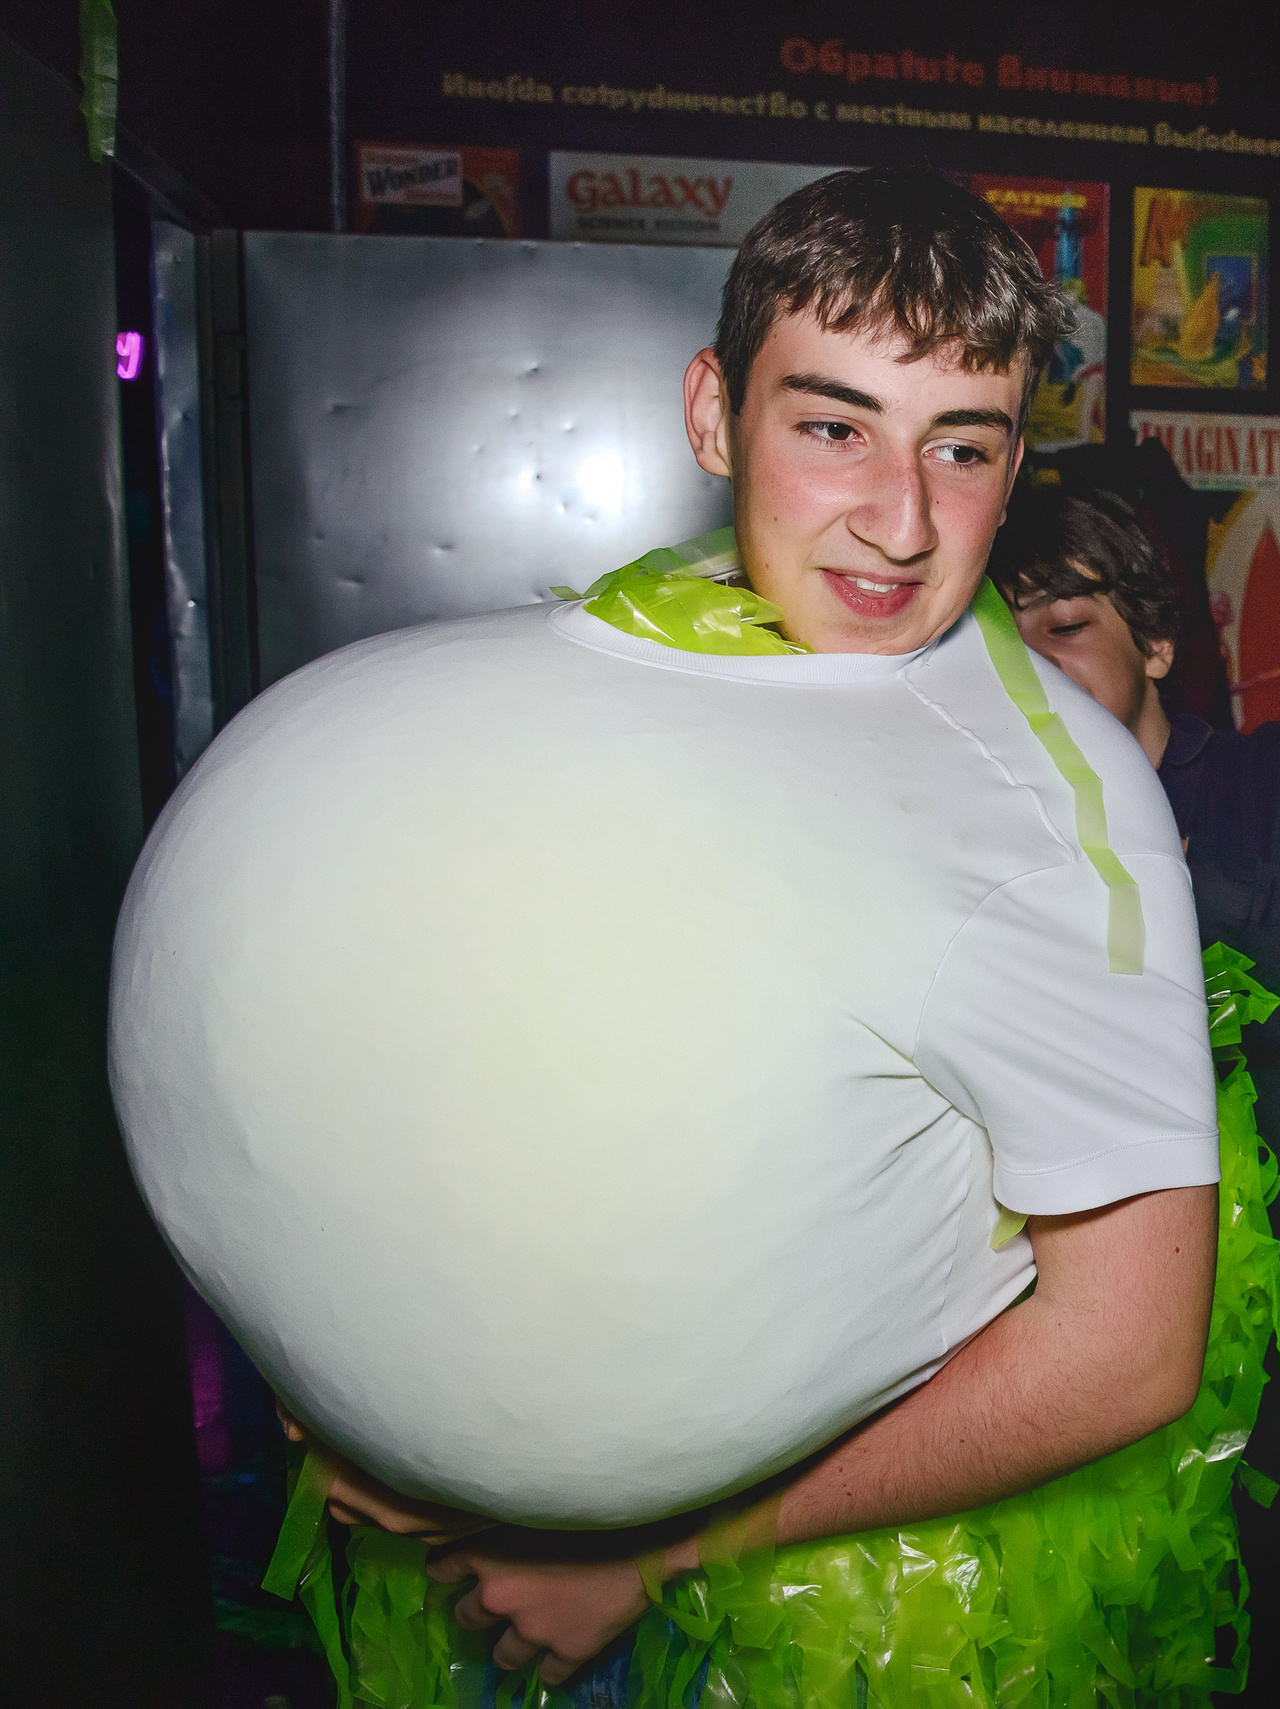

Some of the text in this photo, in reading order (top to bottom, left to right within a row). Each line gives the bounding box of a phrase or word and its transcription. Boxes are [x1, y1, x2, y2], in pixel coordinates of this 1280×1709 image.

[441, 71, 554, 103] Иногда
[814, 102, 830, 121] с
[836, 101, 972, 131] местным
[977, 111, 1149, 145] населением
